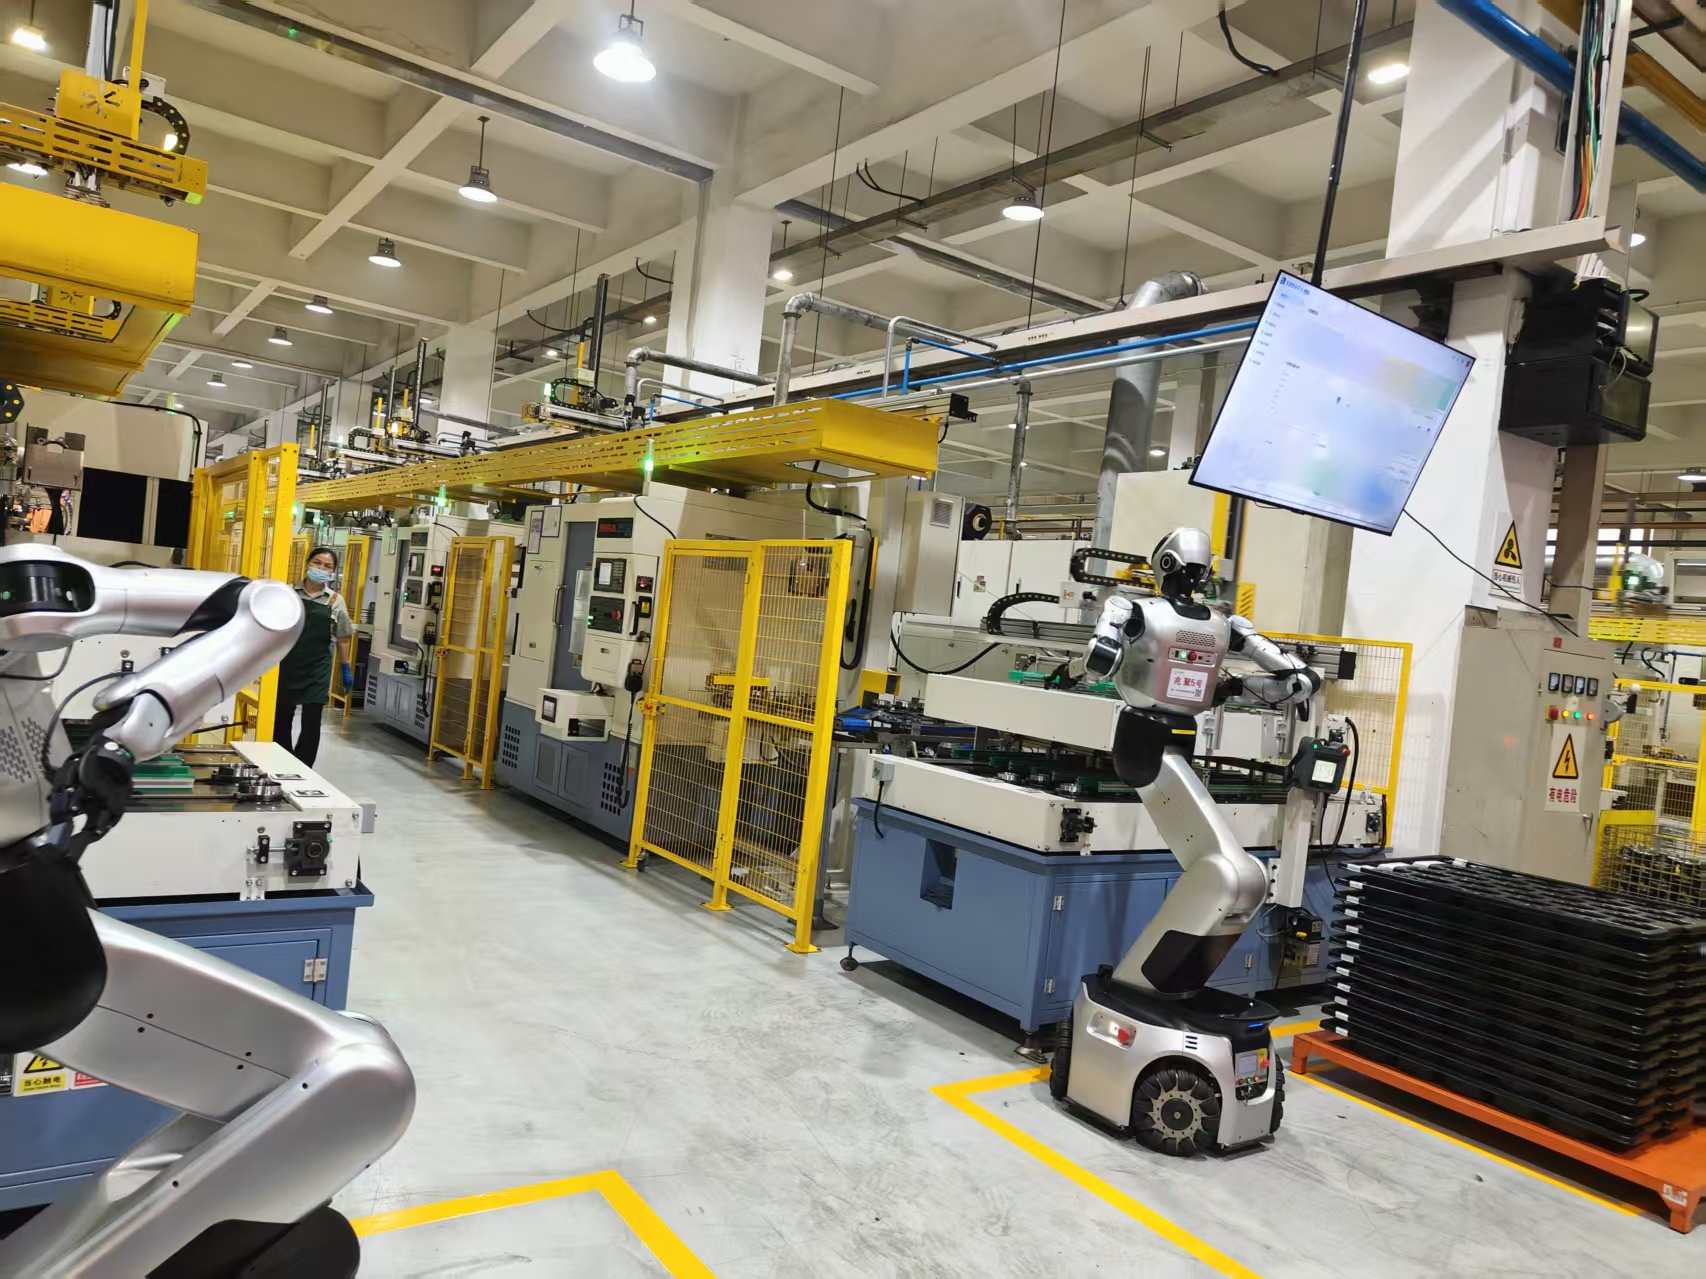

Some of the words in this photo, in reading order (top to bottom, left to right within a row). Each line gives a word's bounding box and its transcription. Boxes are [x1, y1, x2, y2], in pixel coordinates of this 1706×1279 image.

[1549, 787, 1577, 803] 有电危险
[24, 1076, 61, 1087] 当心触电
